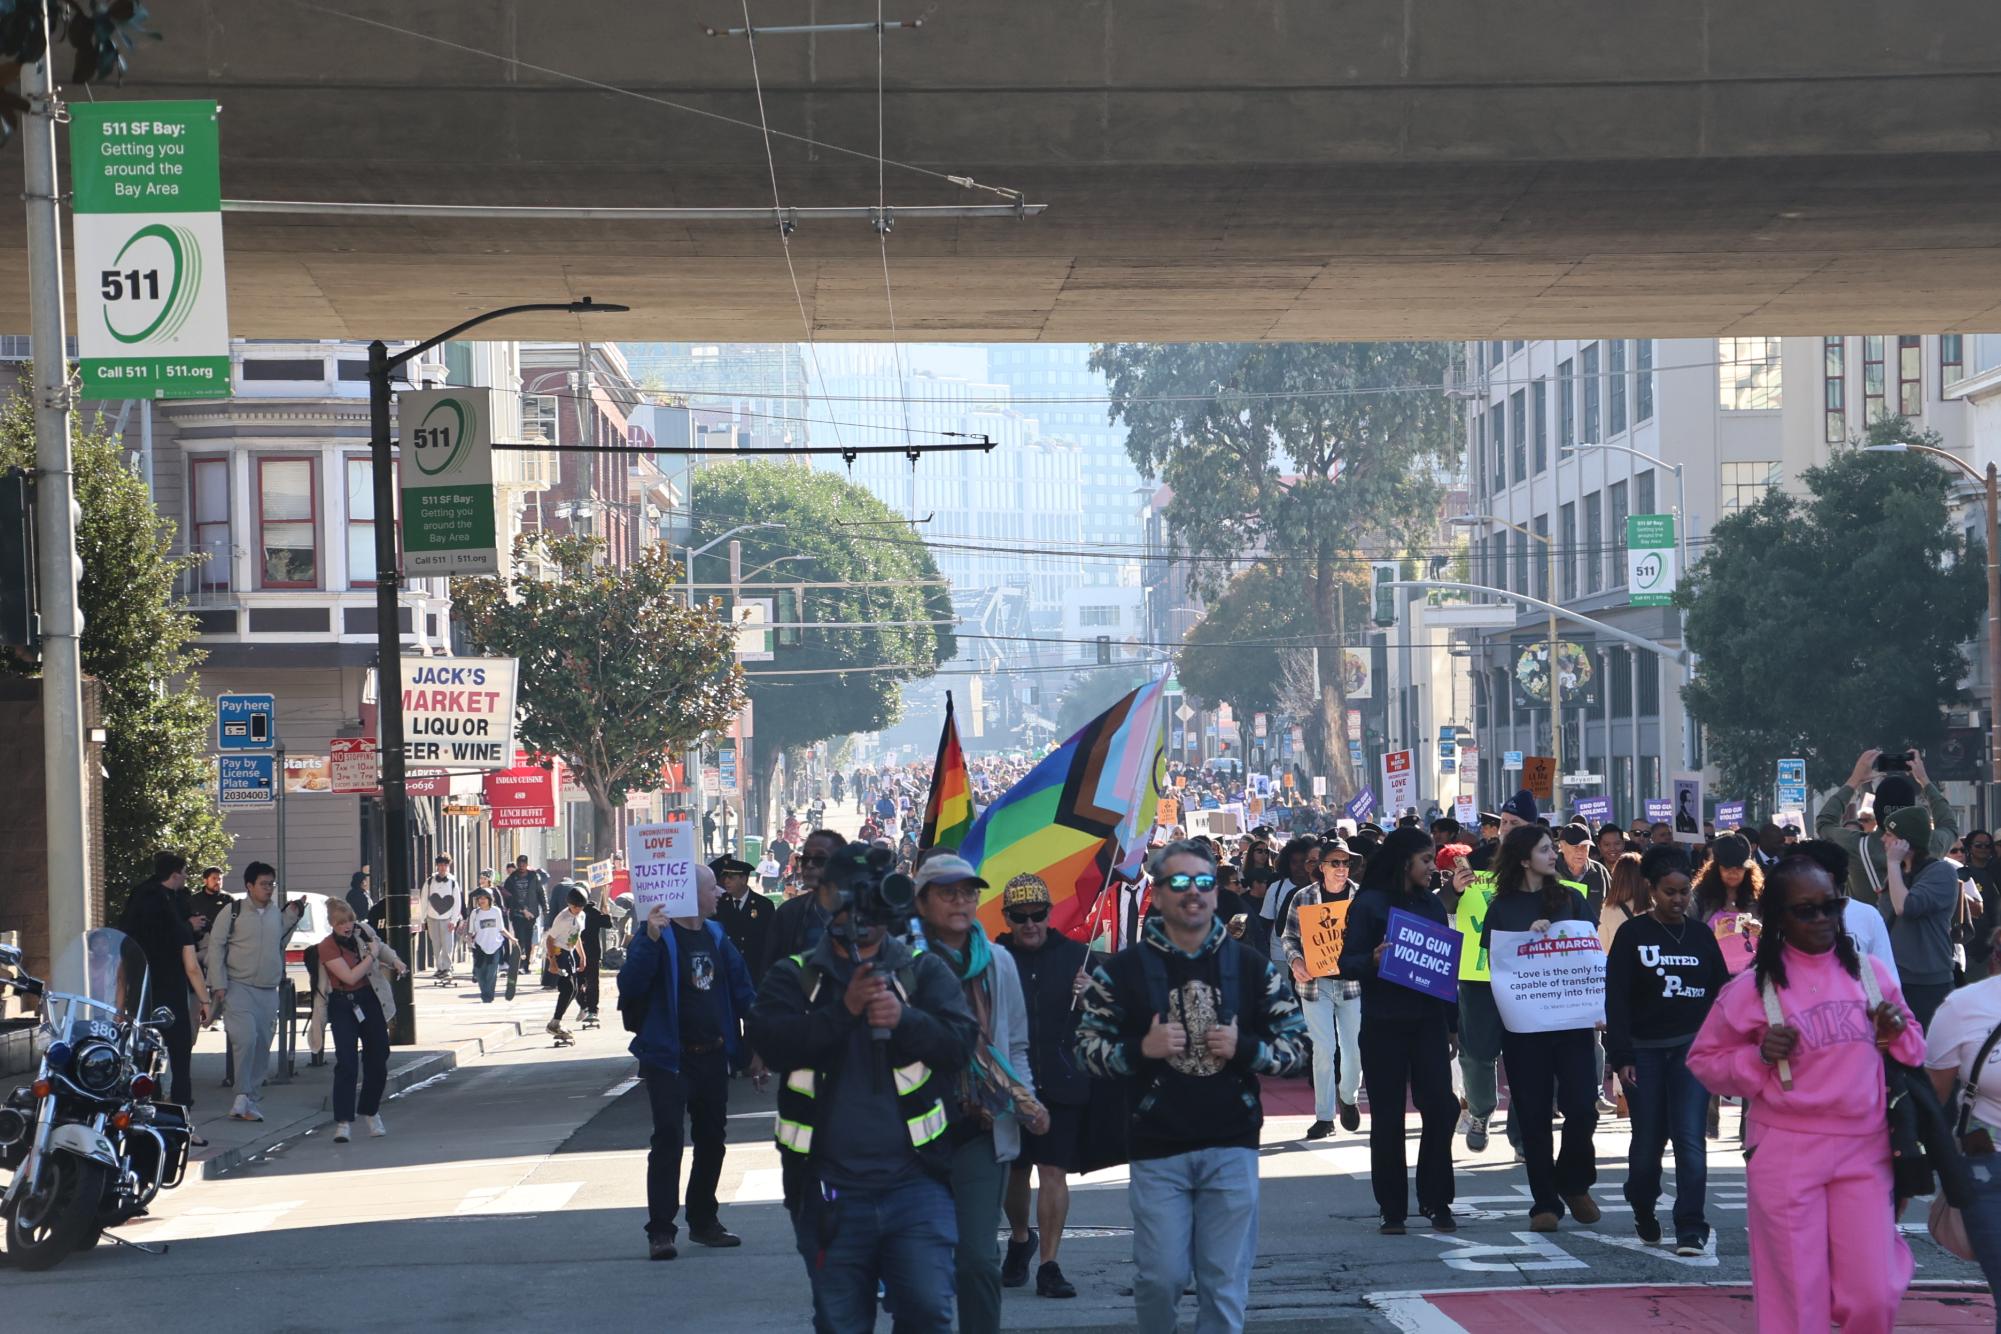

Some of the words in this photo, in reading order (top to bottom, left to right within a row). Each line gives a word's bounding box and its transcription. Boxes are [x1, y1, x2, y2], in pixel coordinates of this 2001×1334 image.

[103, 122, 127, 135] 511
[131, 122, 150, 135] SF
[153, 122, 186, 137] Bay:
[101, 143, 154, 158] Getting
[159, 145, 184, 157] you
[104, 163, 155, 176] around
[160, 163, 183, 175] the
[115, 183, 141, 198] Bay
[146, 182, 179, 195] Area
[101, 269, 159, 301] 511
[97, 366, 123, 378] Call
[126, 366, 147, 378] 511
[166, 365, 213, 379] 511.org
[413, 427, 450, 449] 511
[422, 496, 438, 505] 511
[439, 495, 451, 504] SF
[453, 494, 474, 505] Bay:
[421, 509, 455, 519] Getting
[457, 509, 473, 518] you
[423, 520, 455, 530] around
[457, 520, 472, 529] the
[429, 534, 447, 544] Bay
[450, 532, 470, 542] Area
[415, 556, 431, 565] Call
[432, 555, 446, 563] 511
[457, 554, 487, 564] 511.org
[1636, 566, 1655, 577] 511
[222, 701, 242, 713] Pay
[244, 700, 270, 710] here
[332, 752, 344, 761] NO
[345, 753, 375, 761] STOPPING
[404, 742, 439, 760] EER
[452, 743, 502, 760] WINE
[222, 759, 242, 770] Pay
[244, 758, 257, 770] by
[223, 769, 260, 778] License
[496, 776, 518, 784] INDIAN
[518, 775, 543, 783] CUISINE
[223, 779, 249, 788] Plate
[1392, 779, 1406, 788] LOVE
[1570, 776, 1593, 784] Bryant
[224, 791, 269, 800] 20304003
[521, 808, 543, 816] BUFFET
[1579, 807, 1608, 816] VIOLENCE
[644, 837, 673, 850] LOVE
[635, 862, 689, 878] JUSTICE
[636, 878, 689, 891] HUMANITY
[1399, 927, 1424, 946] END
[1426, 937, 1451, 957] GUN
[1529, 941, 1553, 952] MLK
[1556, 939, 1596, 949] MARCH
[1394, 944, 1452, 976] VIOLENCE
[1543, 969, 1551, 977] is
[1553, 967, 1569, 976] the
[1571, 965, 1591, 976] only
[1510, 980, 1547, 992] capable
[1550, 979, 1559, 988] of
[1530, 991, 1561, 1000] enemy
[1564, 988, 1583, 997] into
[90, 1020, 118, 1040] 380
